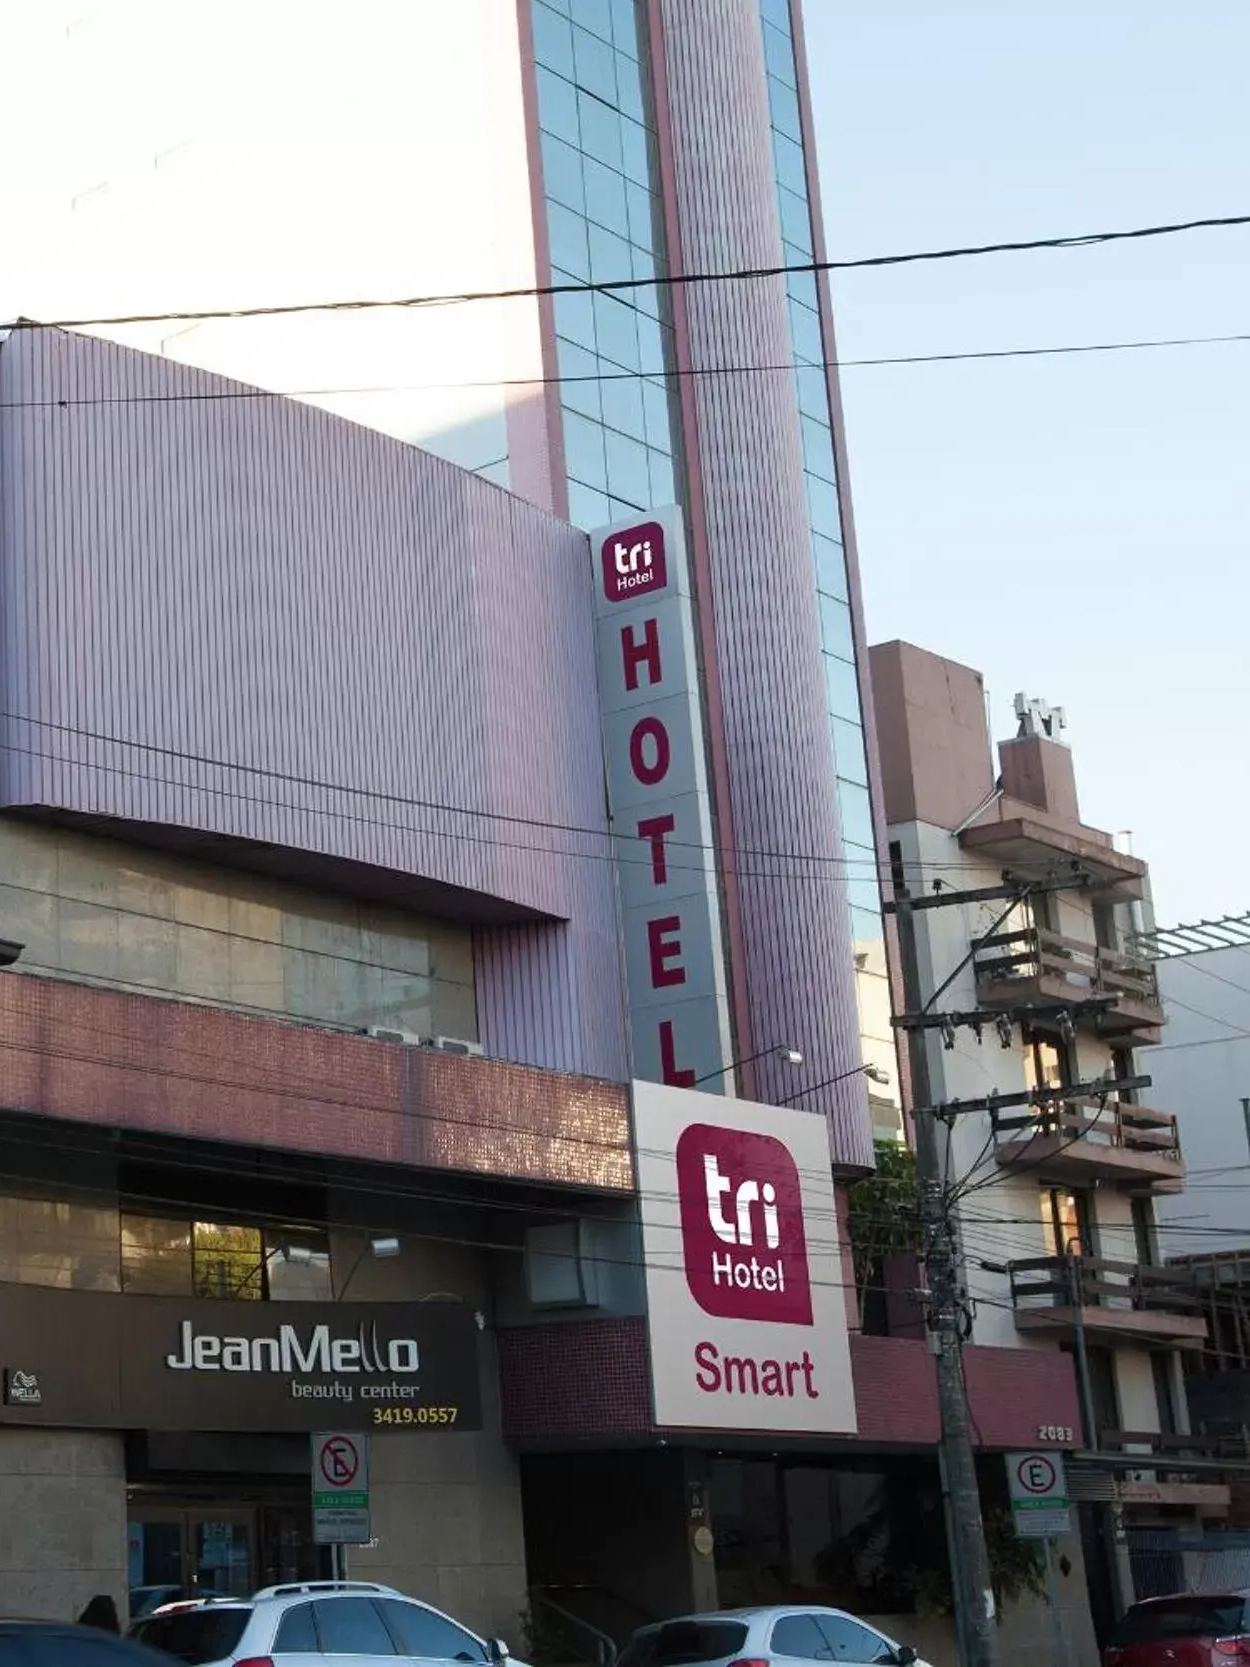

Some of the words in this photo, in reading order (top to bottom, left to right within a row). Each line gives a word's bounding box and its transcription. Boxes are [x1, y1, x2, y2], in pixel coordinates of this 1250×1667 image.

[613, 540, 653, 574] tri
[616, 568, 655, 592] Hotel
[620, 618, 696, 1089] HOTEL
[703, 1153, 780, 1250] tri
[711, 1251, 785, 1293] Hotel
[167, 1320, 420, 1373] JeanMello
[694, 1340, 819, 1401] Smart
[11, 1387, 42, 1399] WELLA
[292, 1379, 353, 1402] beauty
[360, 1381, 420, 1398] center
[372, 1406, 458, 1425] 3419.0557
[1037, 1425, 1074, 1441] 2083
[1029, 1464, 1045, 1487] E
